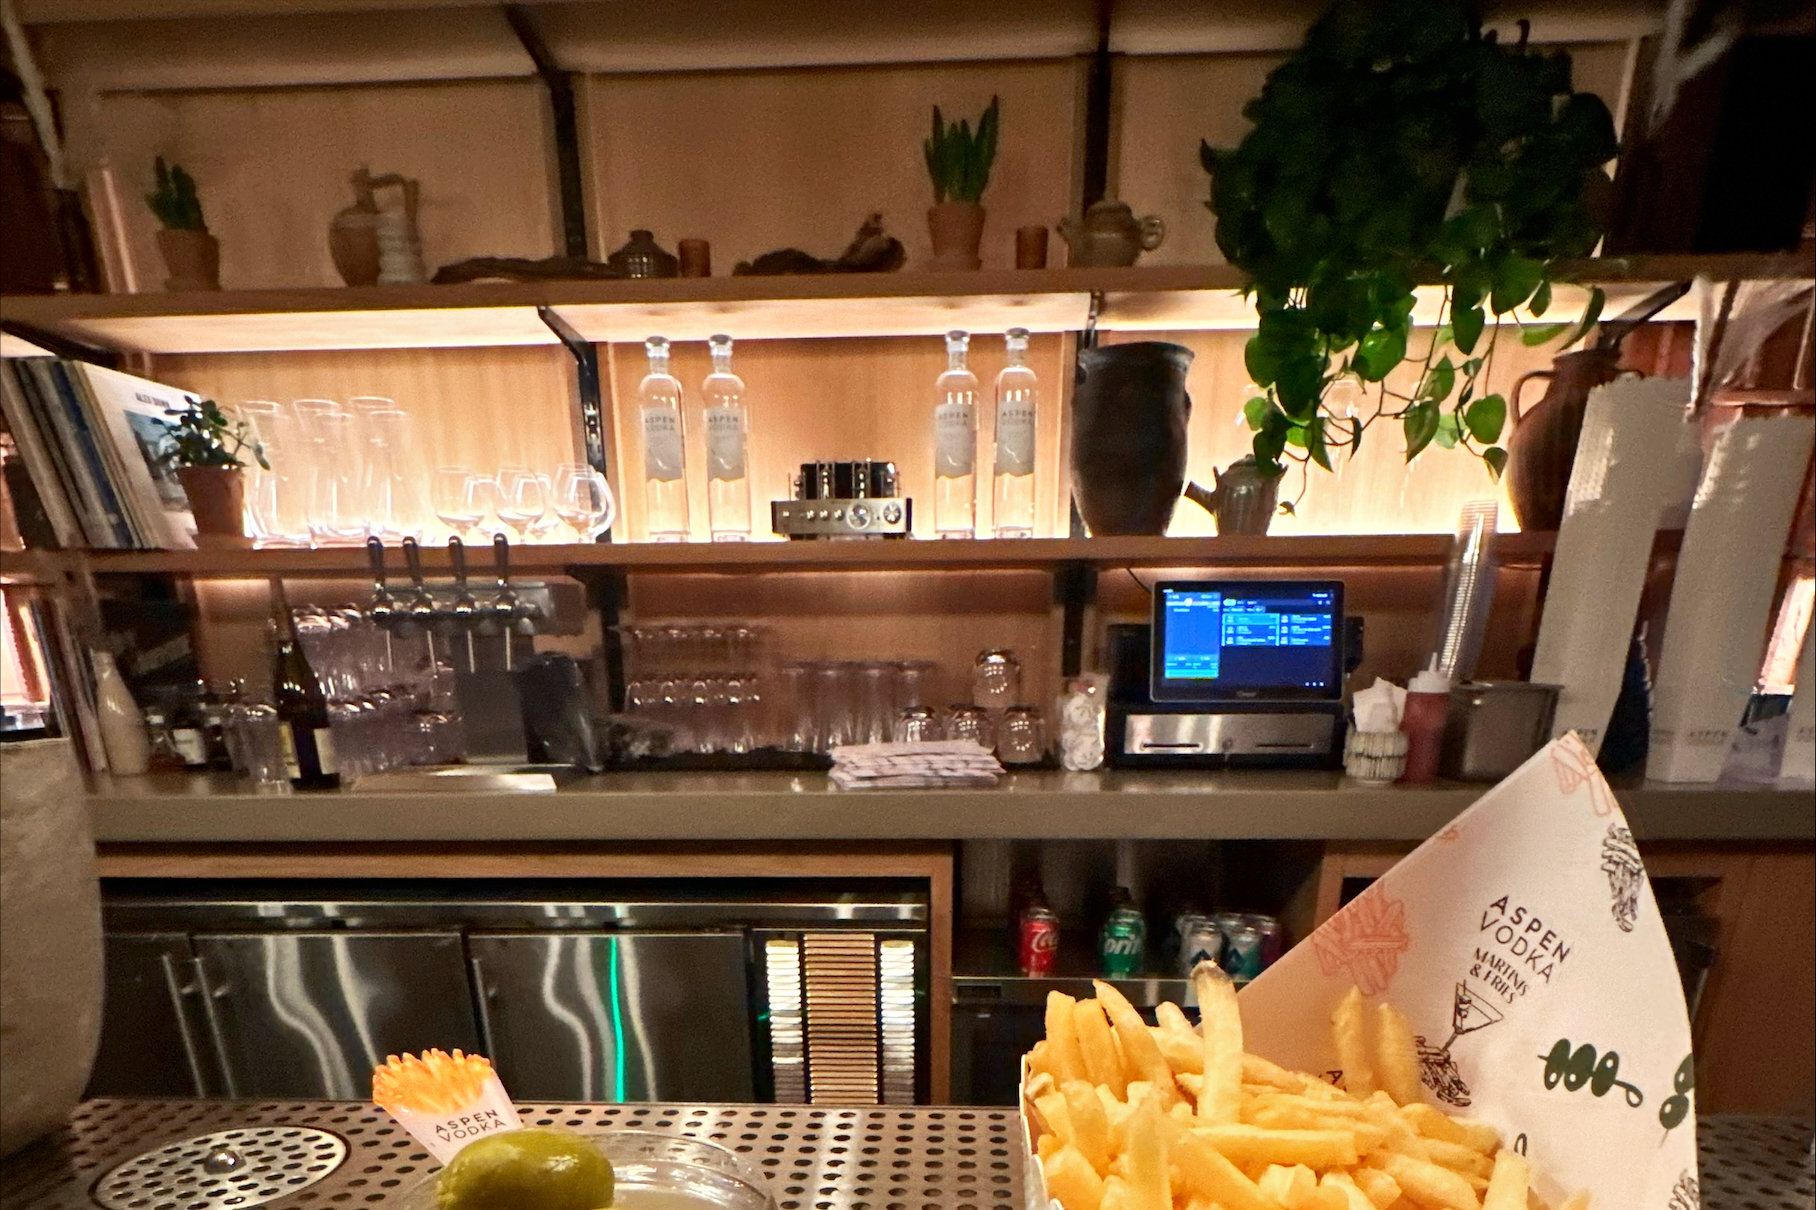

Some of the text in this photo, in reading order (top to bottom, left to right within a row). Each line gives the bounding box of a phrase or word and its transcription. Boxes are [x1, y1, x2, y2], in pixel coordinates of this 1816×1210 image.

[1480, 910, 1554, 984] VODKA
[1489, 895, 1571, 964] ASPEN
[1469, 963, 1515, 1005] & FRIES
[436, 1109, 499, 1134] ASPEN
[438, 1119, 508, 1143] VODKA
